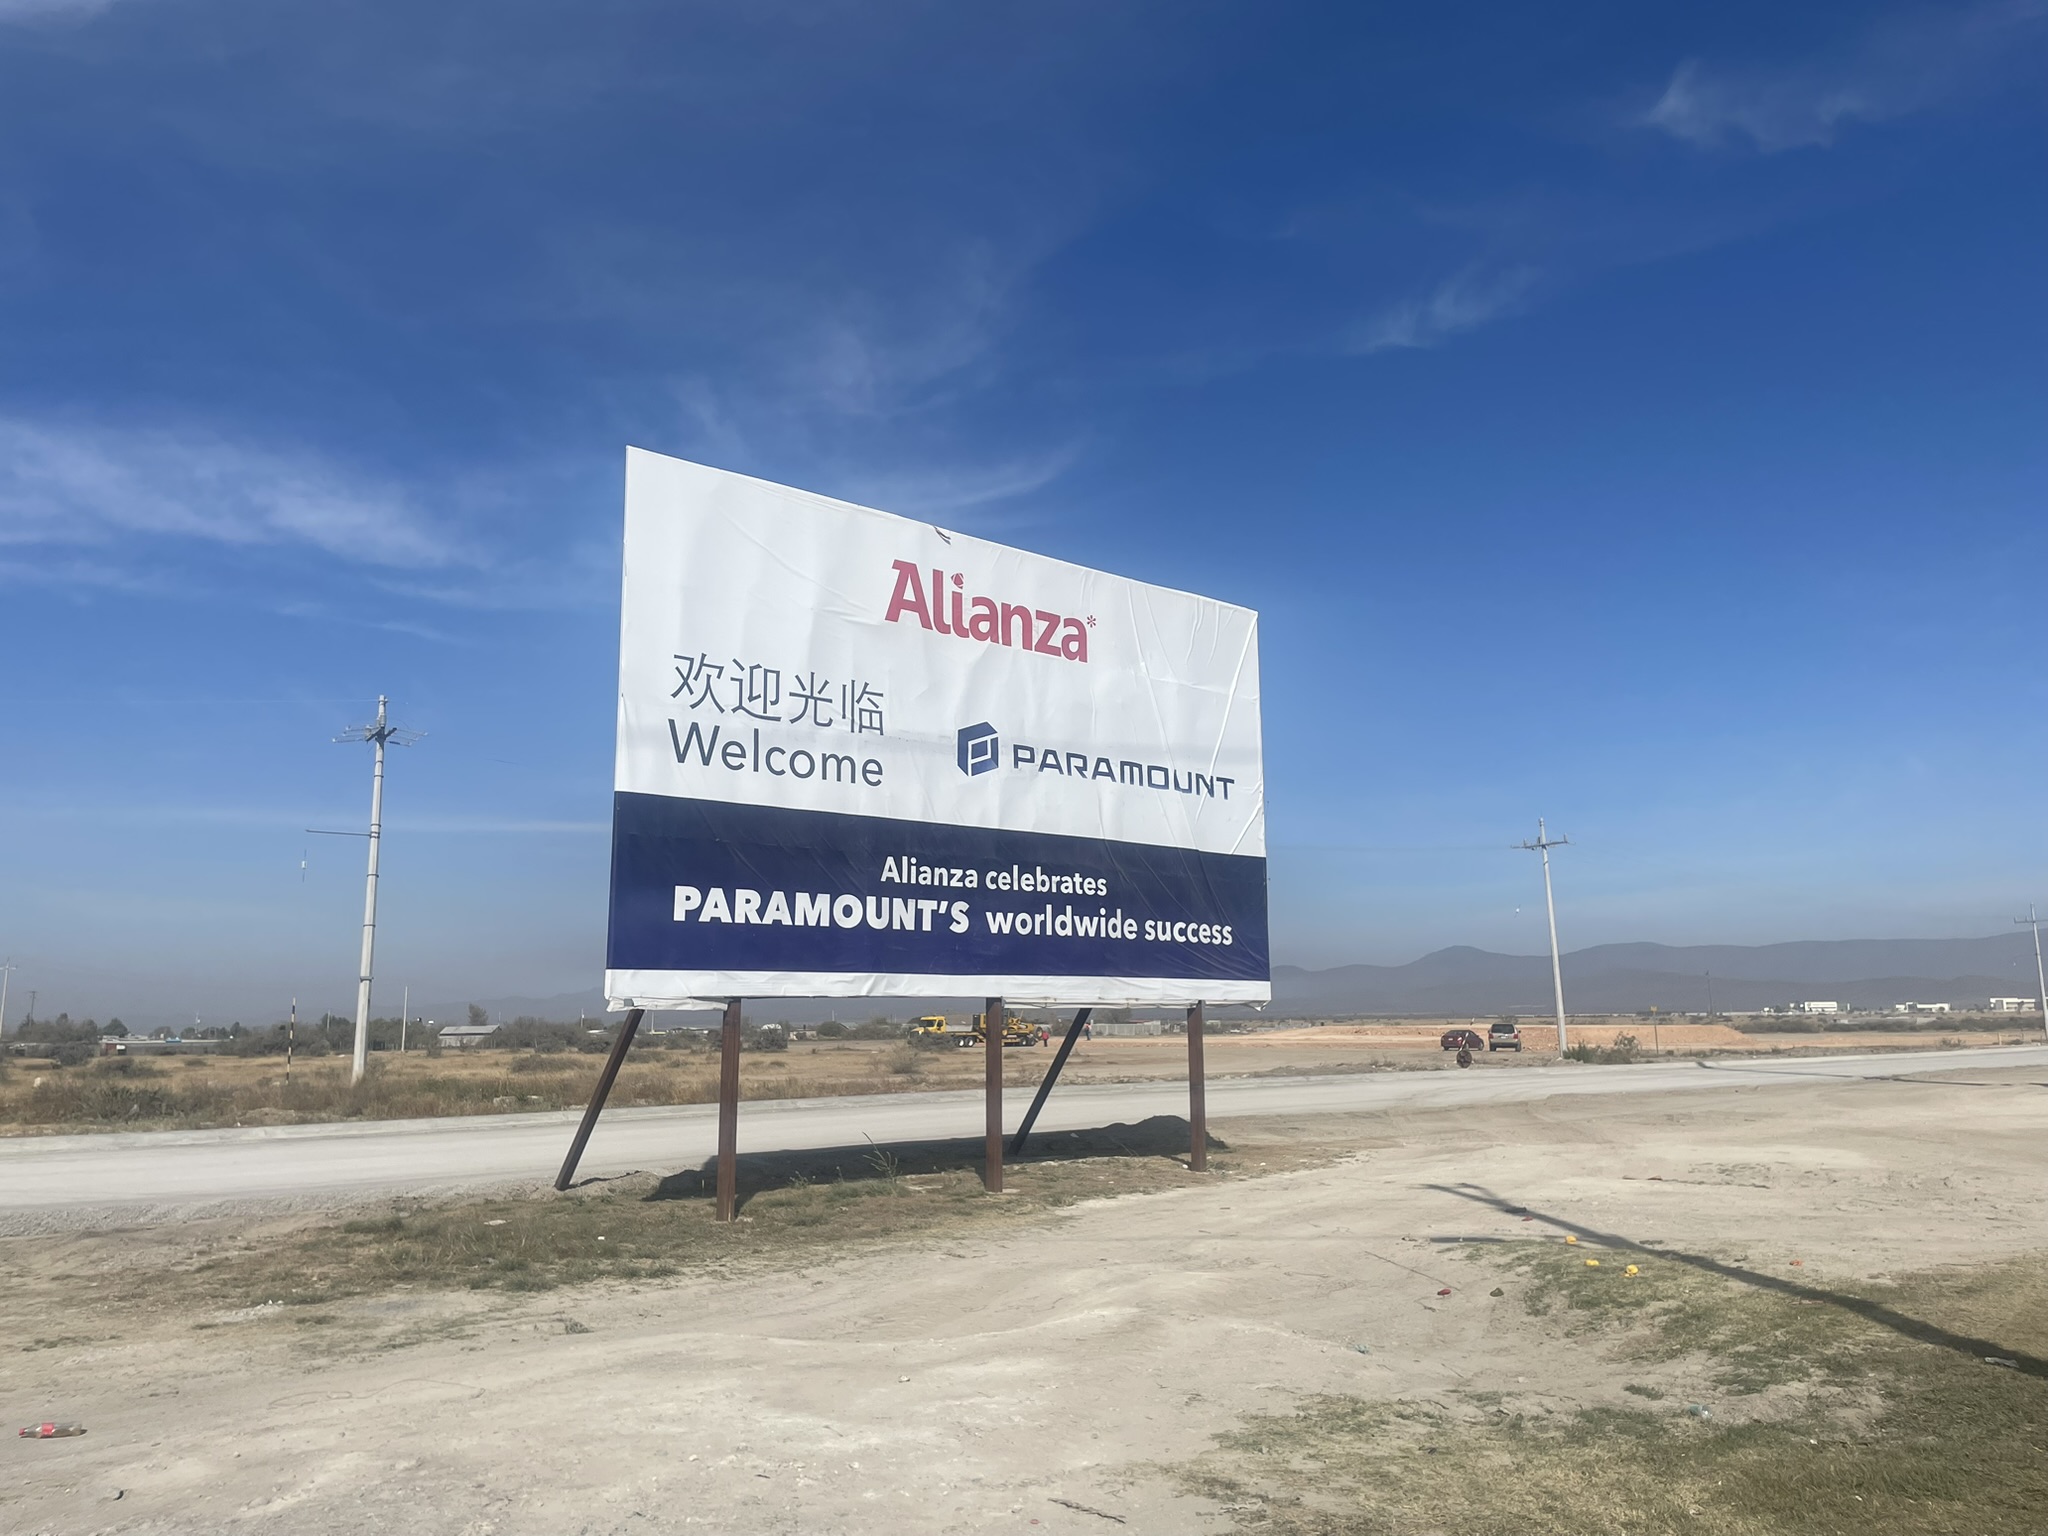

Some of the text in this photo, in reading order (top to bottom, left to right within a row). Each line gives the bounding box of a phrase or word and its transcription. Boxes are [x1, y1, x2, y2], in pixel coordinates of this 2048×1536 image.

[670, 651, 885, 737] 欢迎光临
[667, 717, 884, 788] Welcome
[1012, 743, 1236, 801] PARAMOUNT
[880, 855, 1108, 897] Alianza celebrates
[672, 884, 1234, 947] PARAMOUNT'S worldwide success
